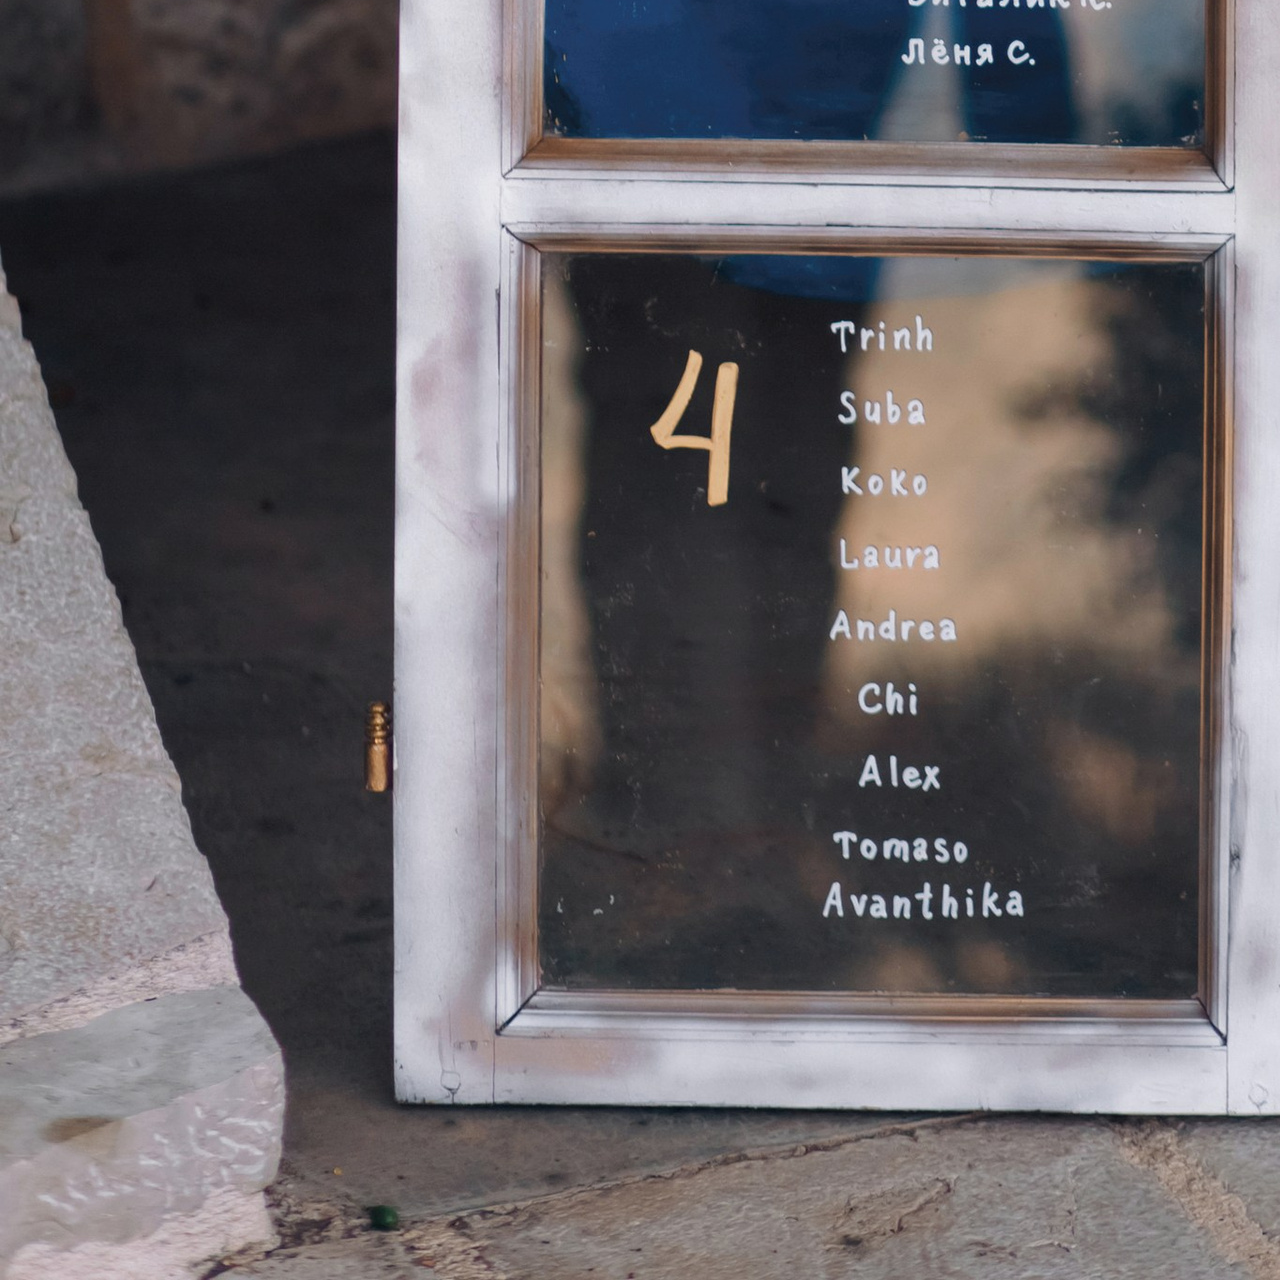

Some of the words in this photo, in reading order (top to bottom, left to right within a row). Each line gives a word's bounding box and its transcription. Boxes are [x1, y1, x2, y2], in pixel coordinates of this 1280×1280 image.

[902, 39, 994, 65] Лёня
[1007, 41, 1035, 65] С.
[831, 317, 933, 352] Trinh
[838, 391, 926, 425] Suba
[650, 349, 738, 506] 4
[839, 539, 940, 570] Laura
[830, 611, 957, 640] Andrea
[858, 683, 919, 714] Chi
[859, 755, 941, 790] Alex
[833, 831, 969, 863] Tomaso
[822, 882, 1025, 919] Avanthika
